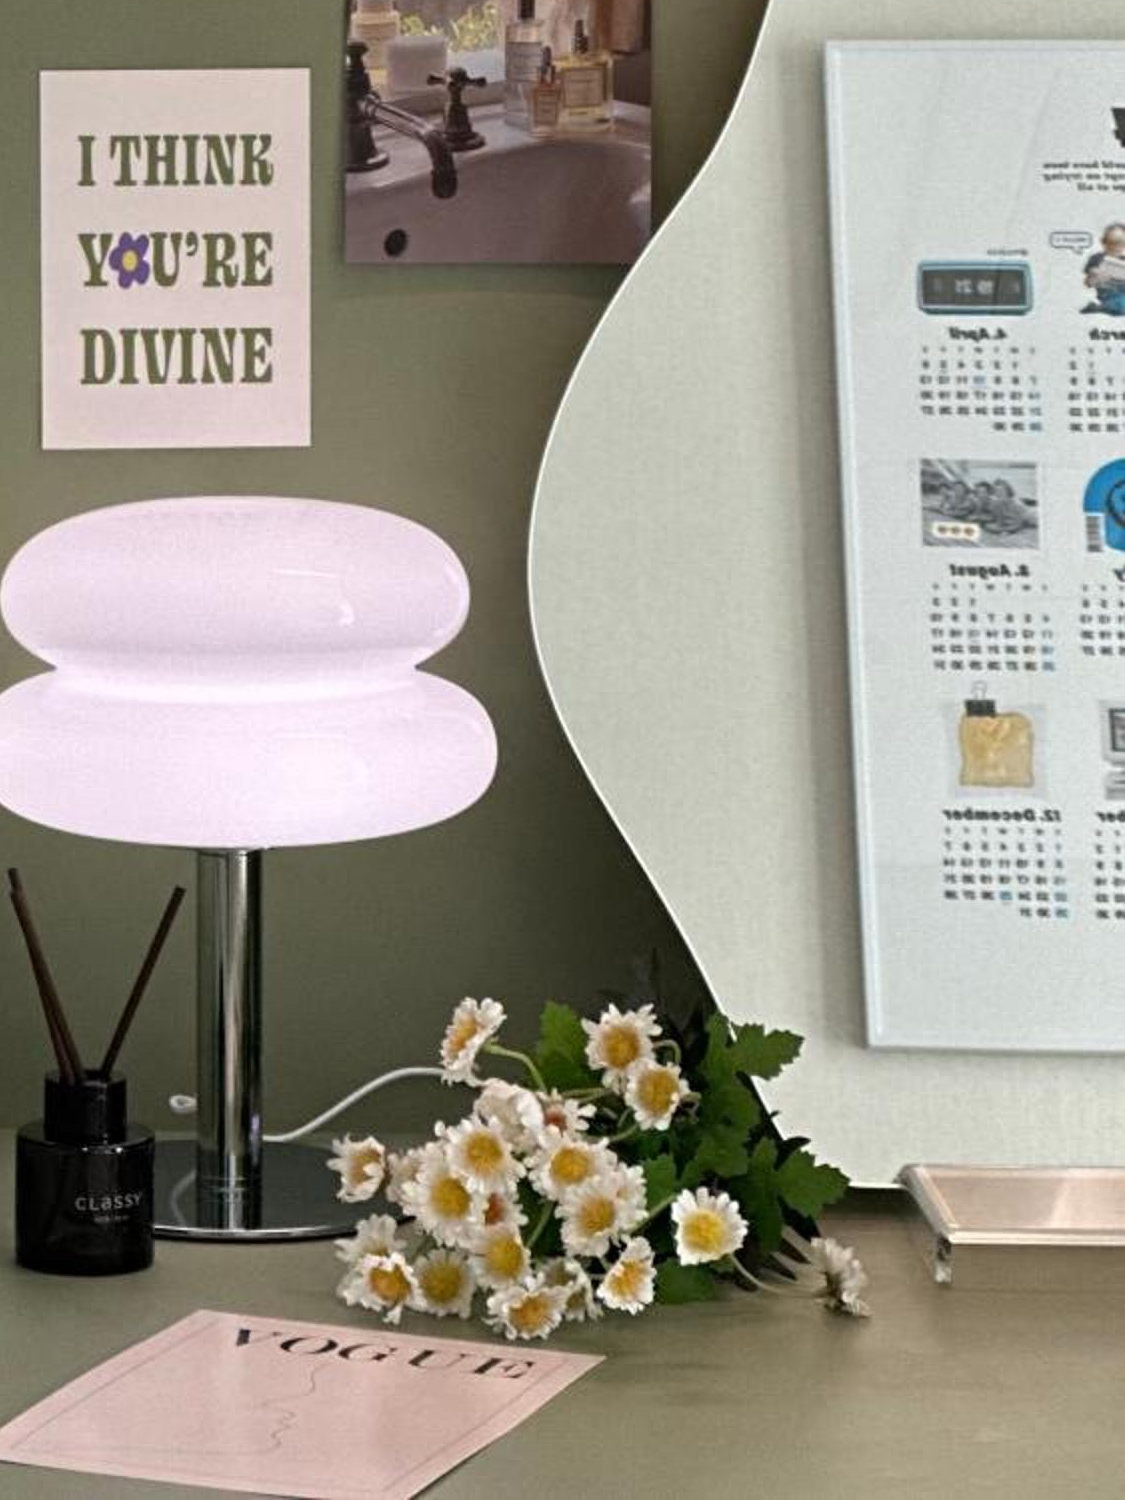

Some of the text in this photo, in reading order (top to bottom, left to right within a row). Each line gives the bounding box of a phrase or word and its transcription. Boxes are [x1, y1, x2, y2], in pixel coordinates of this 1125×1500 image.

[77, 134, 274, 187] I THINK
[80, 327, 273, 385] DIVINE
[236, 1328, 534, 1379] VOGUE
